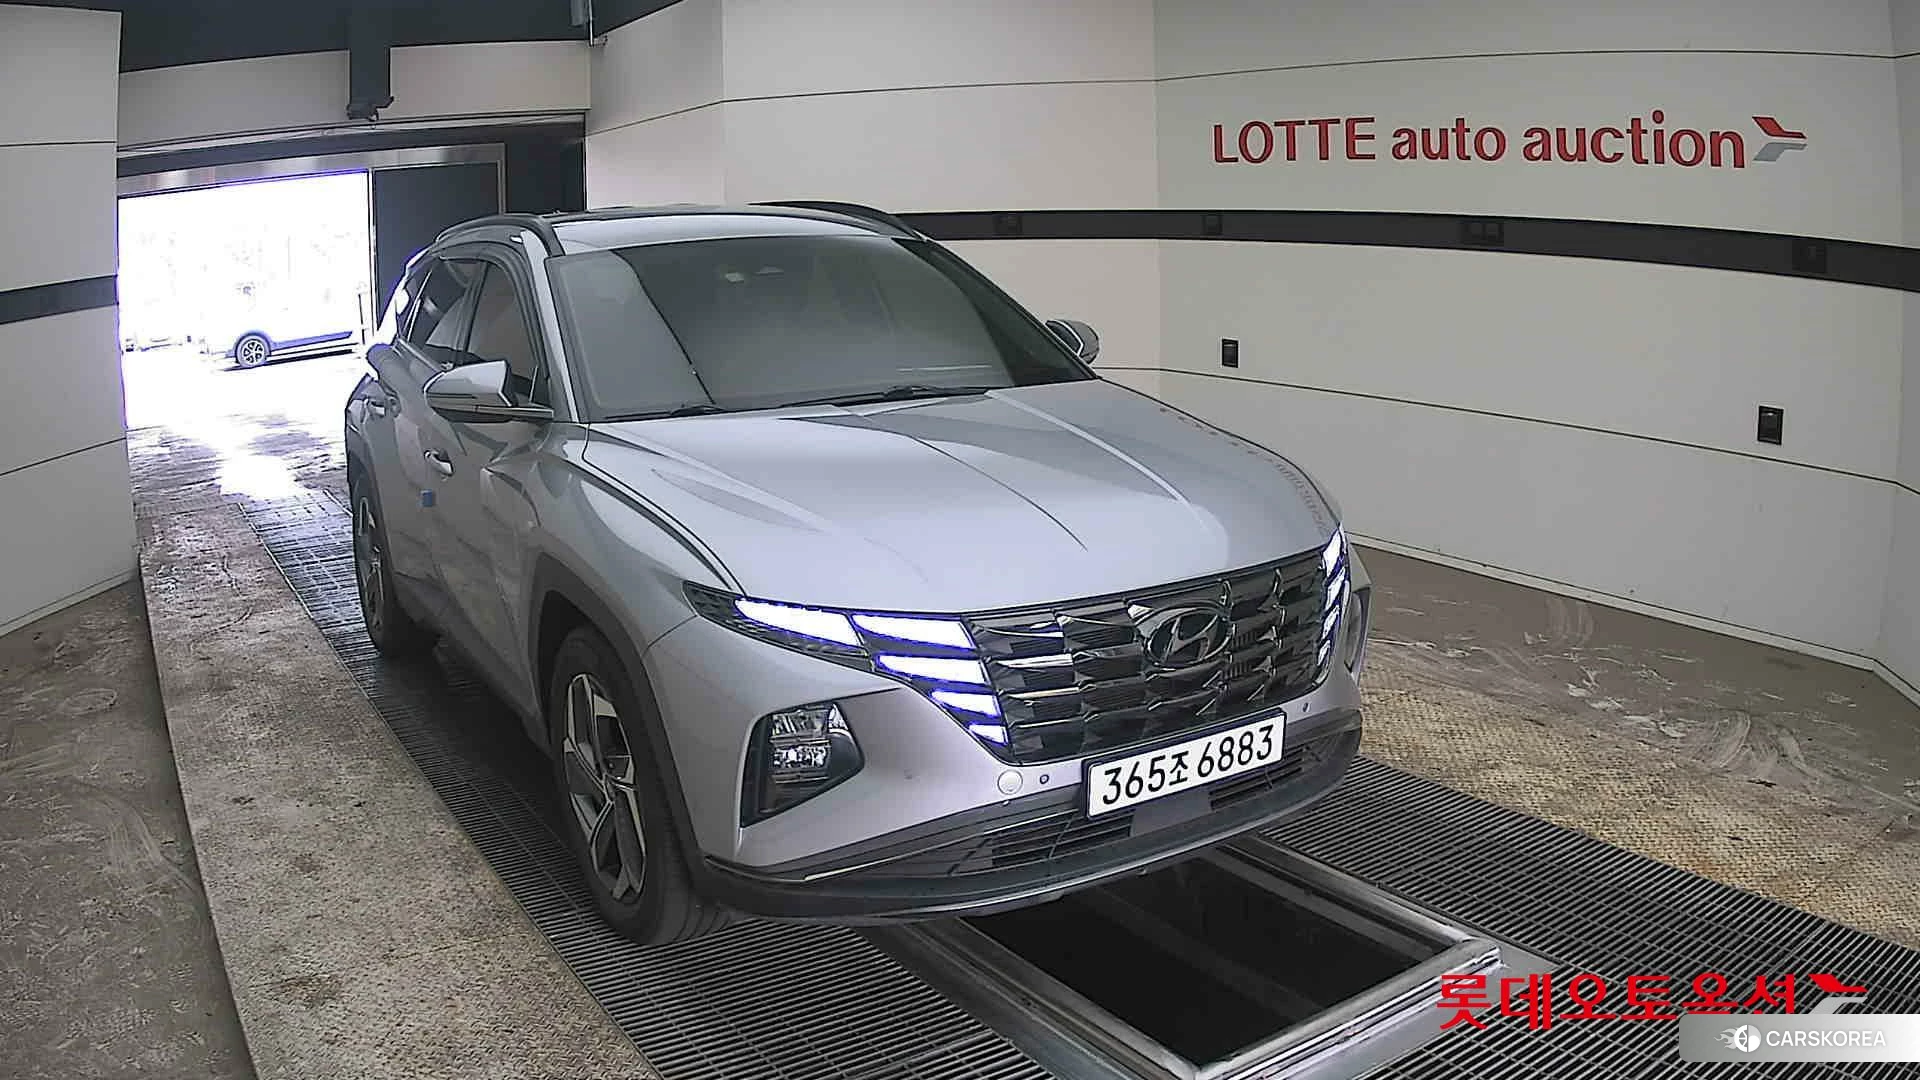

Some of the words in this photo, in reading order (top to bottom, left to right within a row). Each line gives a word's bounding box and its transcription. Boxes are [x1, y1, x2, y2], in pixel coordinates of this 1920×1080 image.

[1213, 117, 1376, 163] LOTTE
[1391, 117, 1507, 161] auto
[1522, 110, 1745, 168] auction
